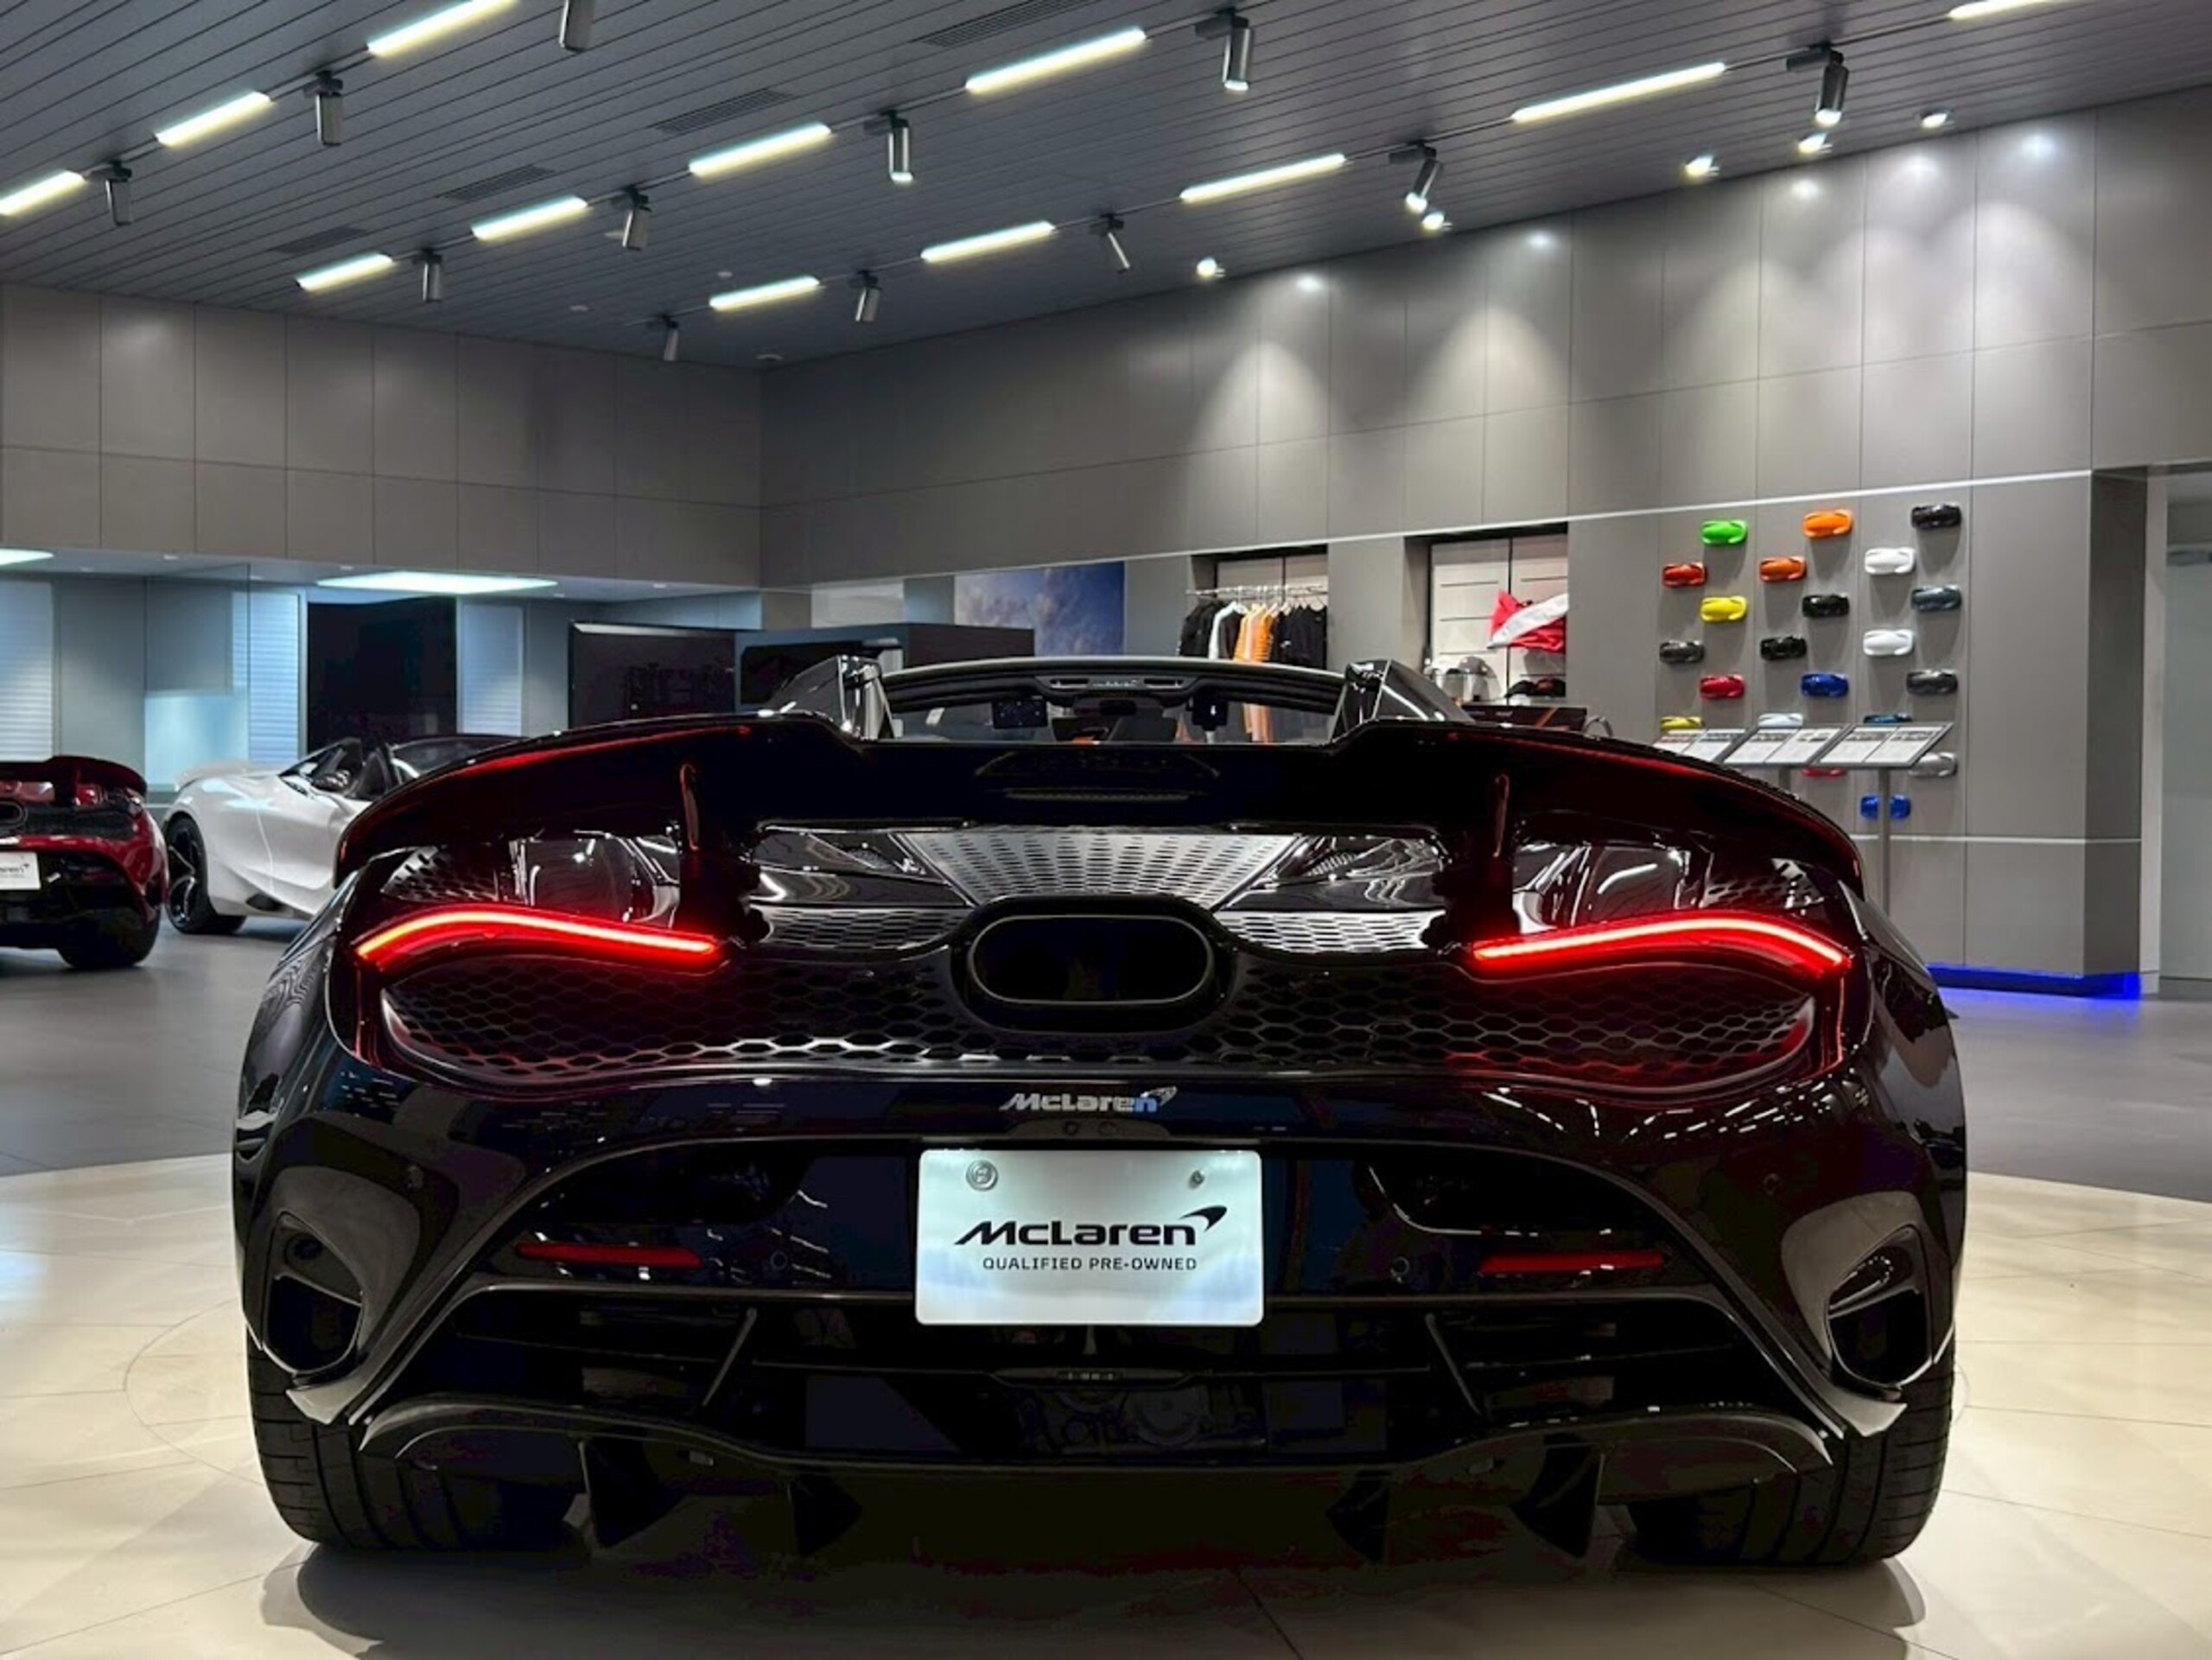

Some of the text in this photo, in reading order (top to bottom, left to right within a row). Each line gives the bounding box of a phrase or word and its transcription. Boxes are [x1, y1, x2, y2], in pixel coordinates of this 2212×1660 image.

[999, 1093, 1157, 1111] McLaren
[954, 1220, 1196, 1245] McLaren
[982, 1256, 1198, 1270] QUALIFIED PRE-OWNED
